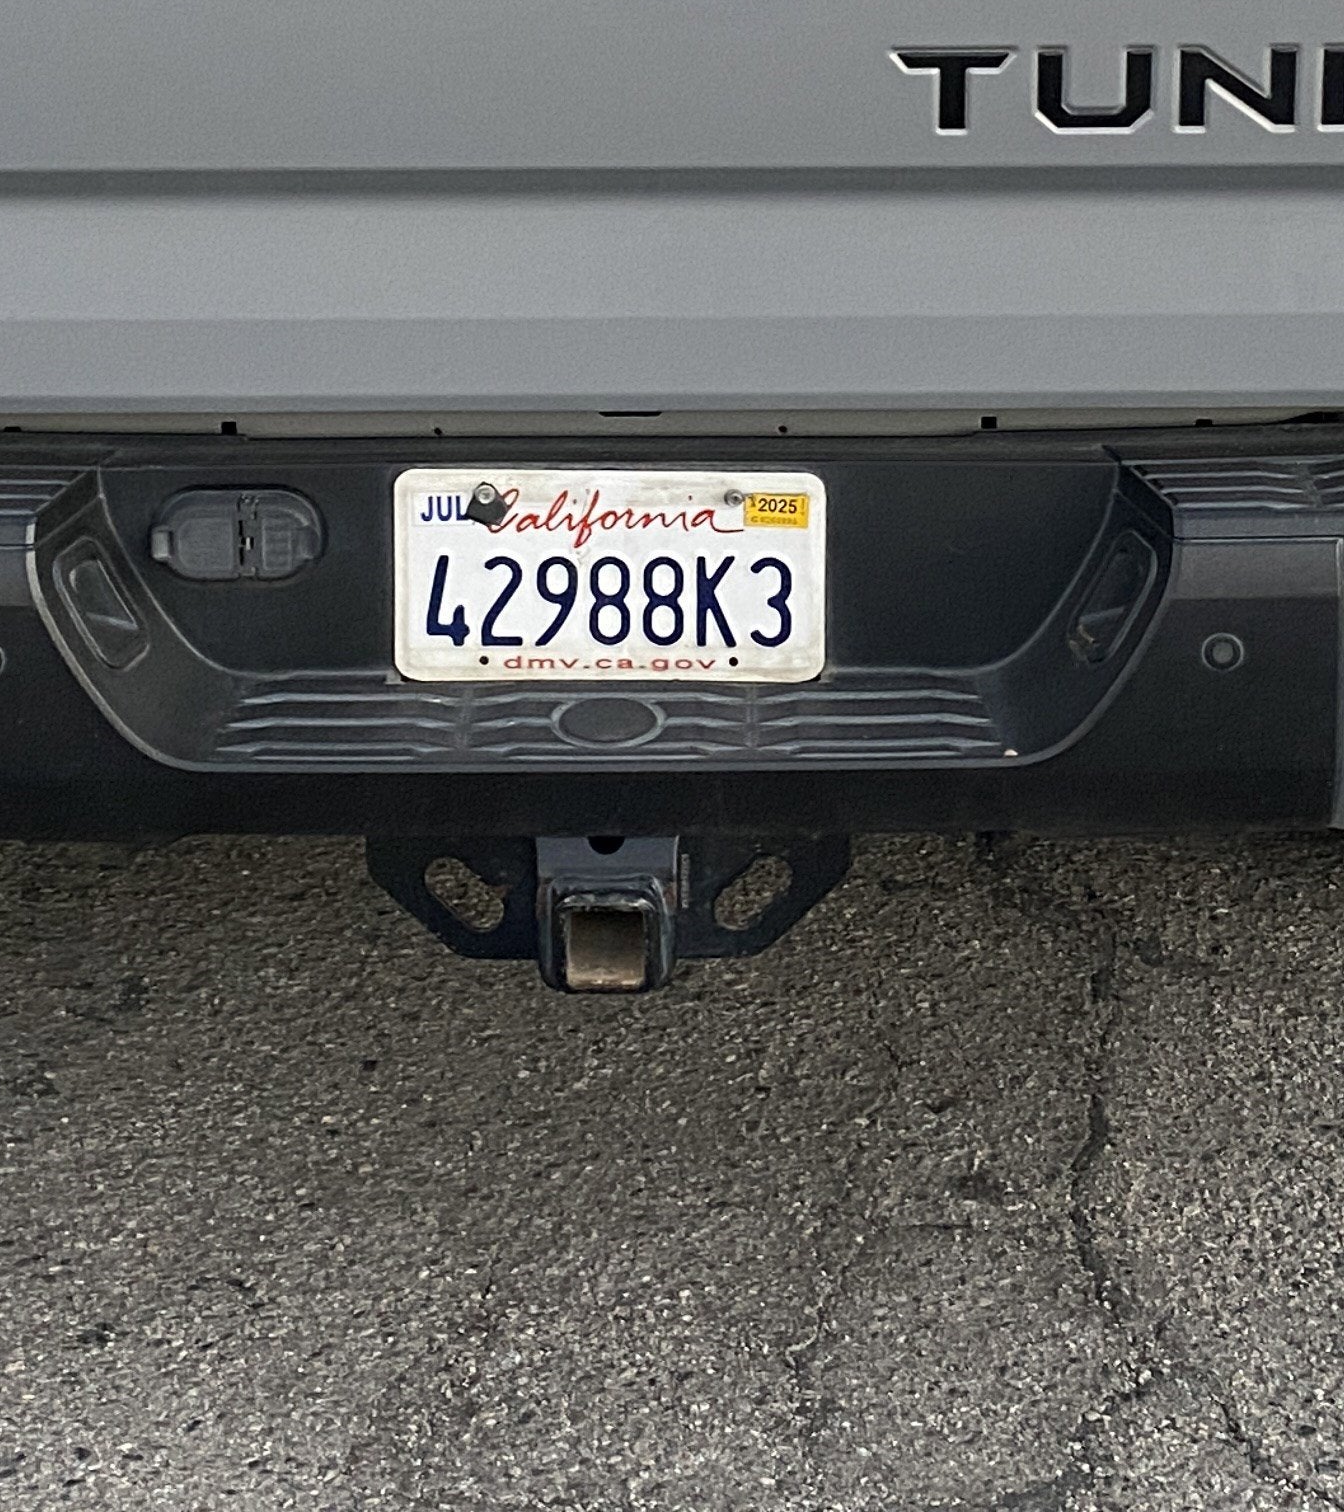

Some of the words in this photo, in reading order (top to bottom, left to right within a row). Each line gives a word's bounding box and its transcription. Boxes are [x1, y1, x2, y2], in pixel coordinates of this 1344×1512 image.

[420, 496, 469, 523] JUL
[487, 489, 744, 548] California
[758, 497, 798, 514] 2025
[425, 554, 793, 648] 42988K3
[504, 655, 717, 672] dmv.ca.gov
